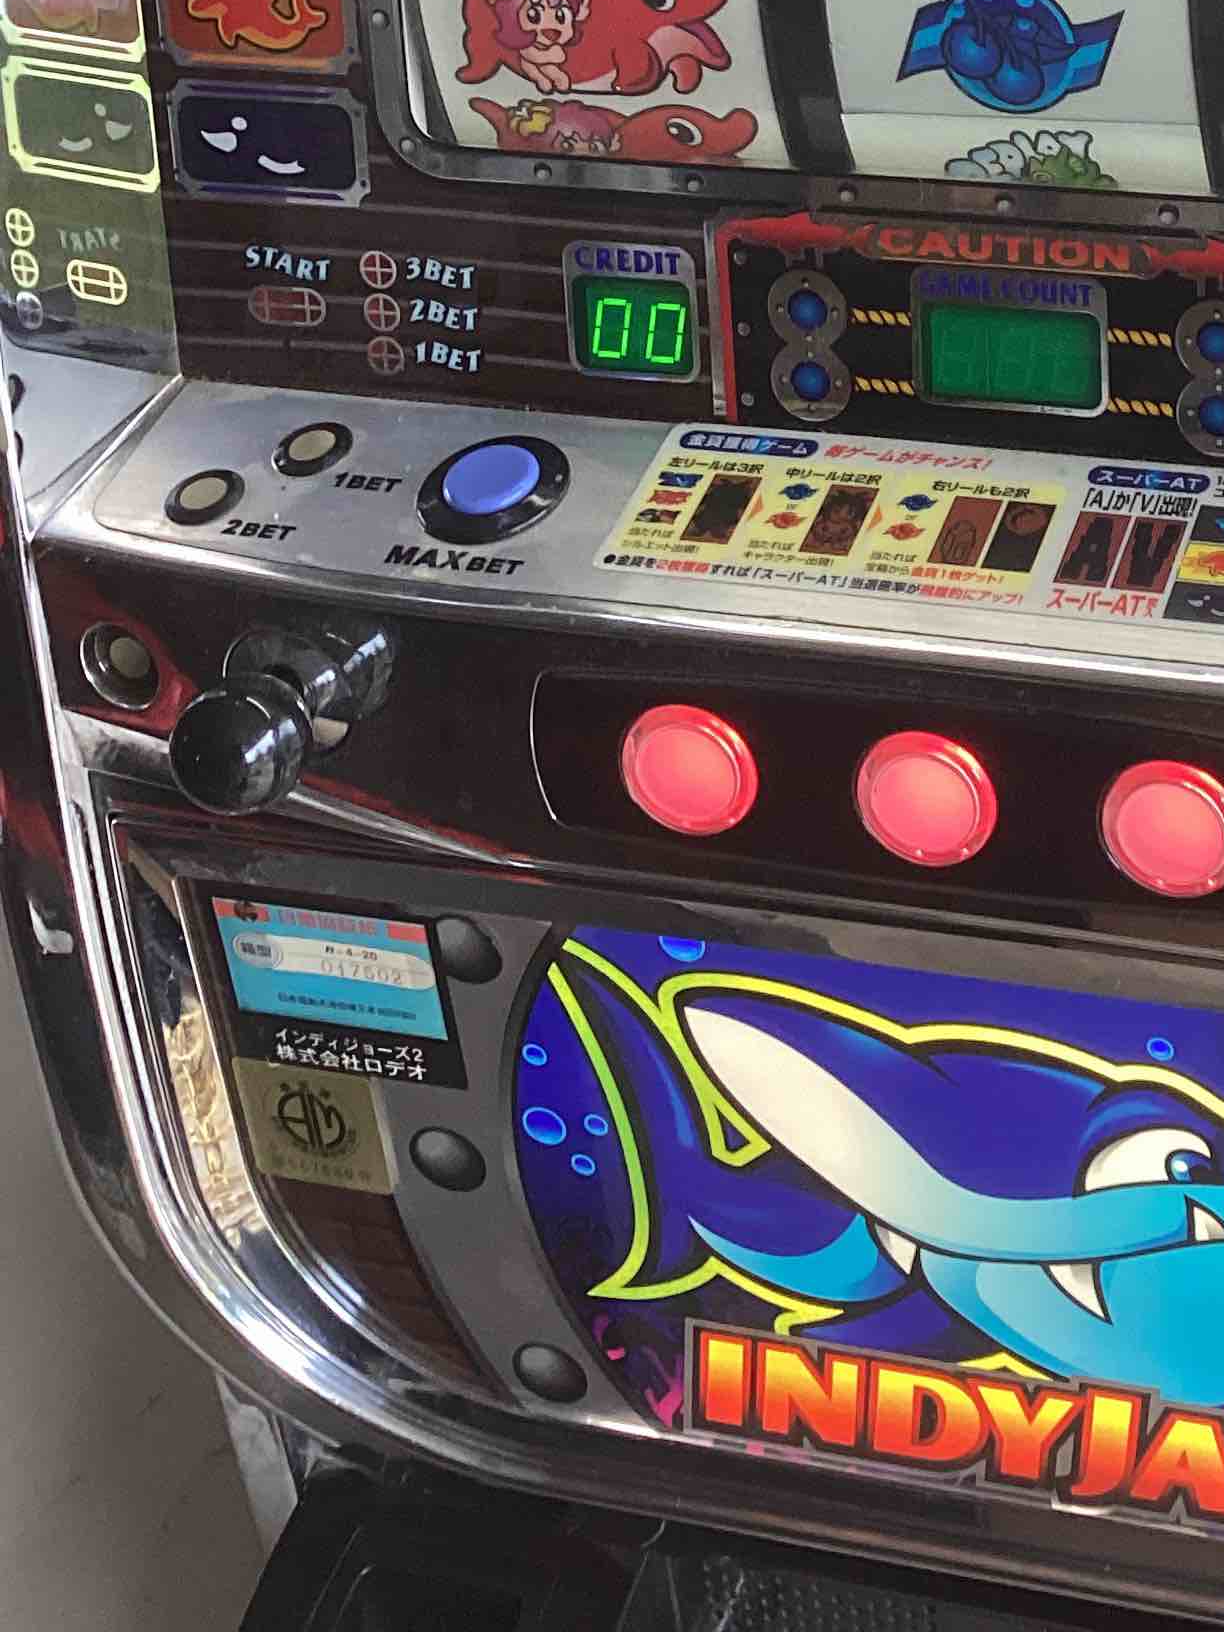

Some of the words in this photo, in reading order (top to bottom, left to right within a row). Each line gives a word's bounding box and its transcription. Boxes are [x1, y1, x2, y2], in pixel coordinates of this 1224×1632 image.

[245, 245, 331, 282] START
[575, 247, 681, 275] CREDIT
[879, 226, 1130, 271] CAUTION
[405, 257, 475, 289] 3BET
[1000, 279, 1093, 307] COUNT
[409, 299, 478, 331] 2BET
[592, 298, 686, 364] 00
[416, 341, 481, 373] 1BET
[333, 471, 402, 493] 1BET
[220, 519, 296, 541] 2BET
[276, 1044, 427, 1081] 株式会社ロデオ
